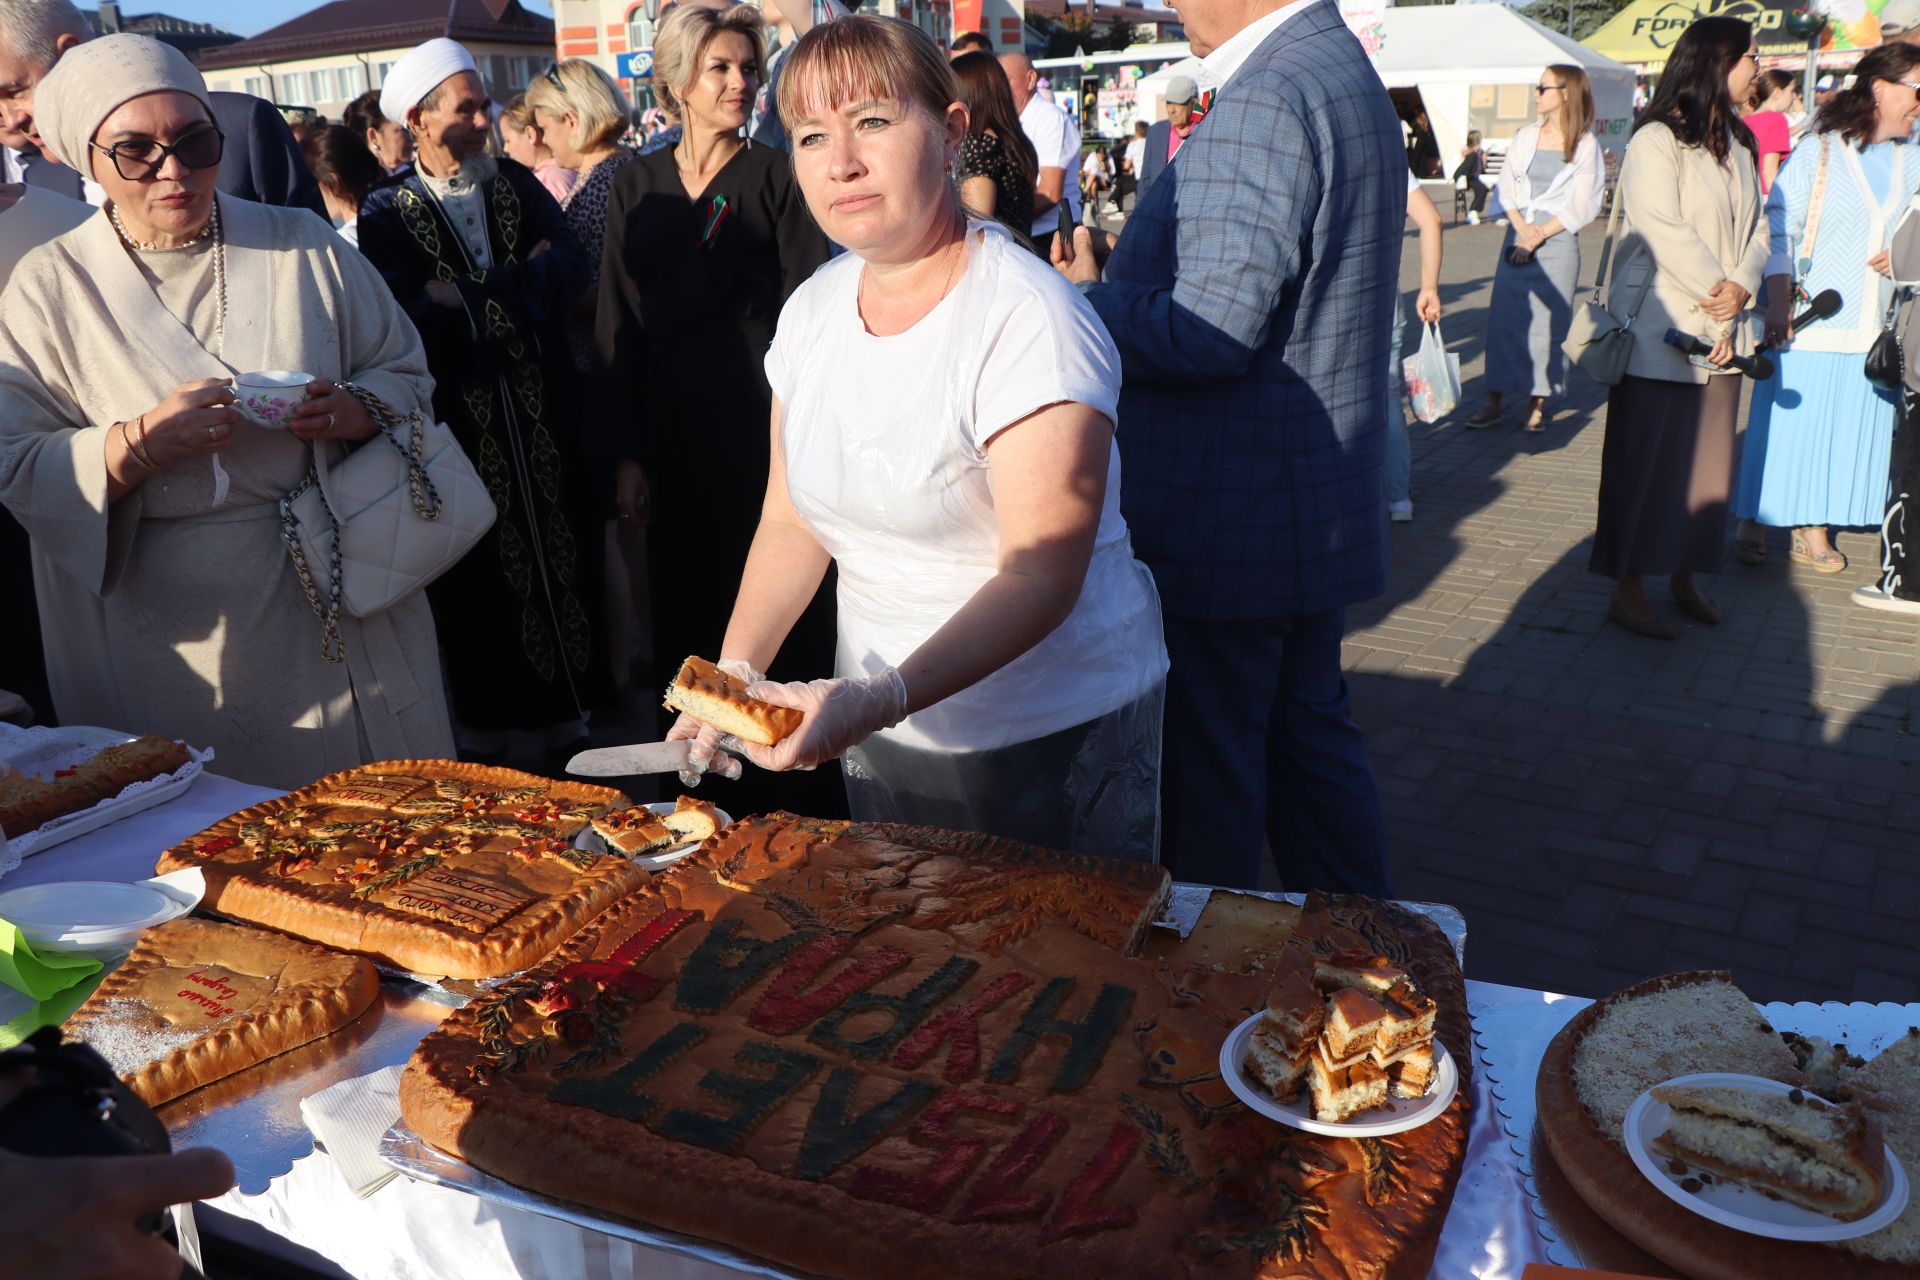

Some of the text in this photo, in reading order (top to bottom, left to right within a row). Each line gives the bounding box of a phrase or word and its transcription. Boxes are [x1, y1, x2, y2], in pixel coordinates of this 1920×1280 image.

[433, 875, 497, 894] ЯГУАР
[398, 895, 476, 924] ОТ КОГО
[451, 895, 499, 914] КАФЕ
[562, 907, 1136, 1095] НУРЛАТ
[545, 1021, 941, 1183] ЛЕТ
